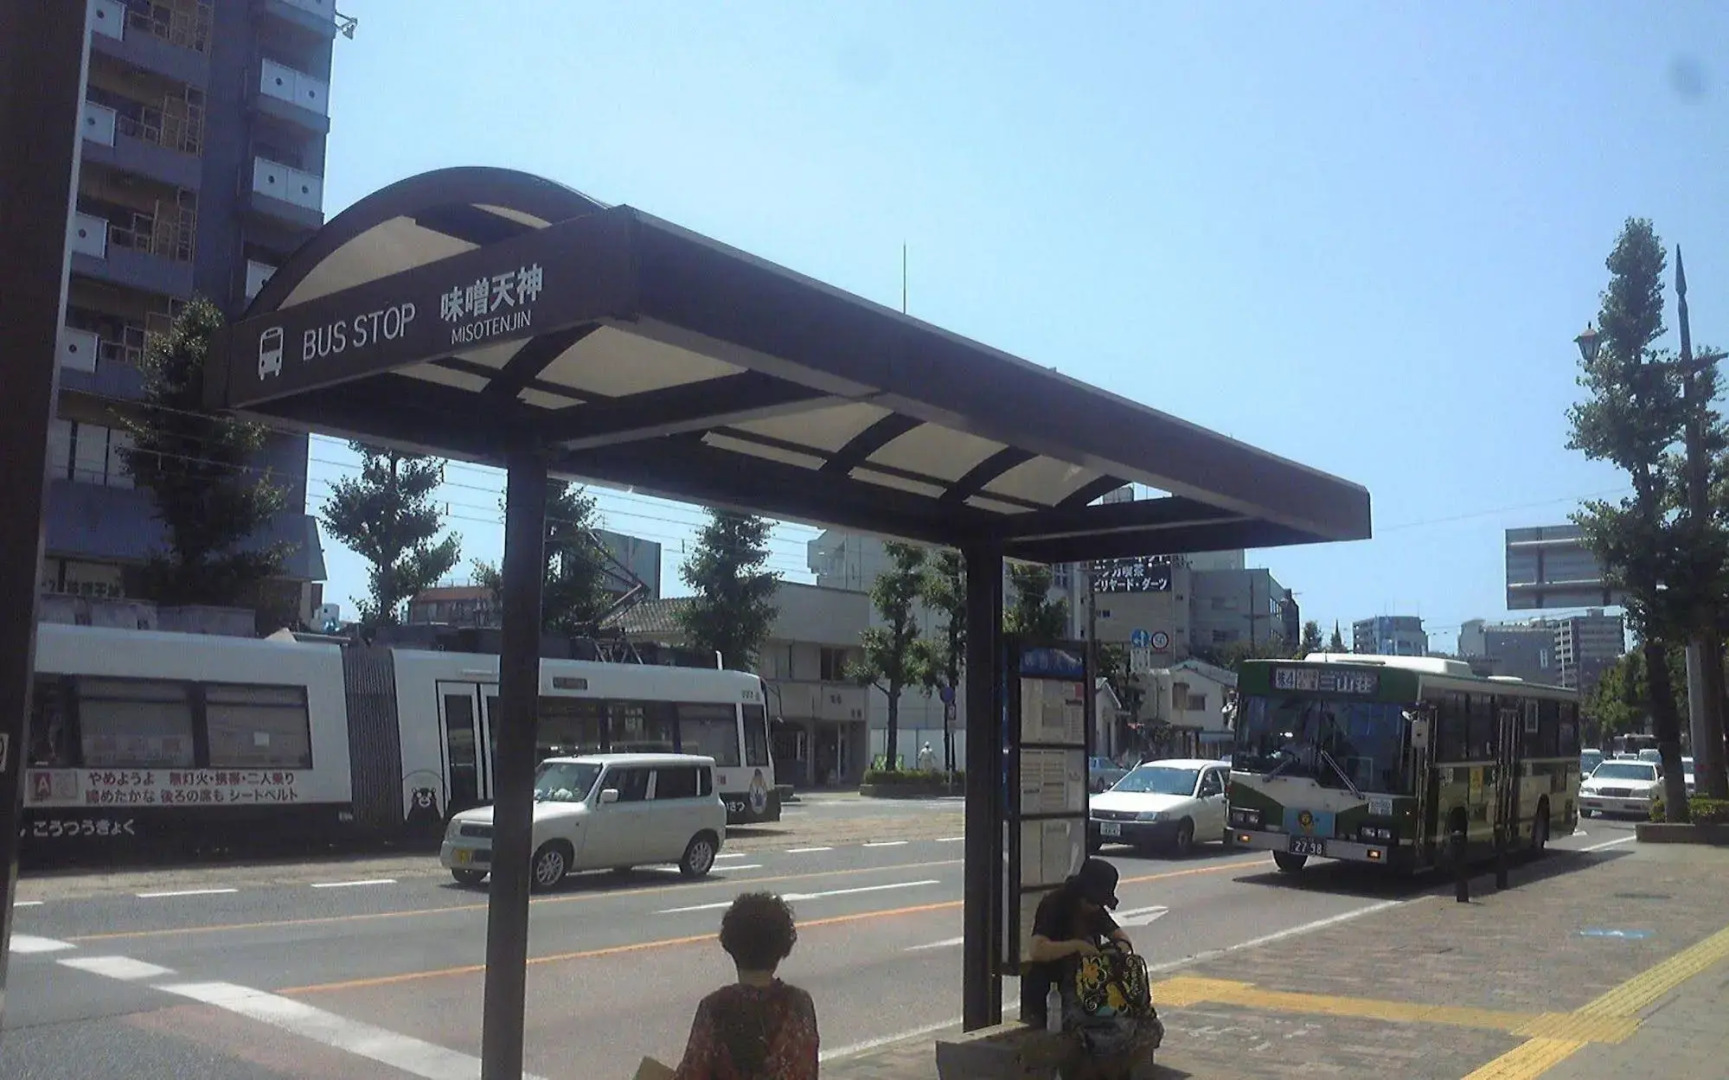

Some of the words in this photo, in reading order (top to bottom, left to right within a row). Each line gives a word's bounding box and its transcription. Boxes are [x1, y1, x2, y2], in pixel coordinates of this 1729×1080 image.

[441, 263, 543, 323] 味噌天神
[302, 320, 347, 361] BUS
[353, 302, 416, 348] STOP
[451, 309, 532, 345] MISOTENJIN
[88, 771, 155, 786] やめようよ
[229, 788, 299, 802] シートベルト
[32, 818, 136, 837] こうつうきょく
